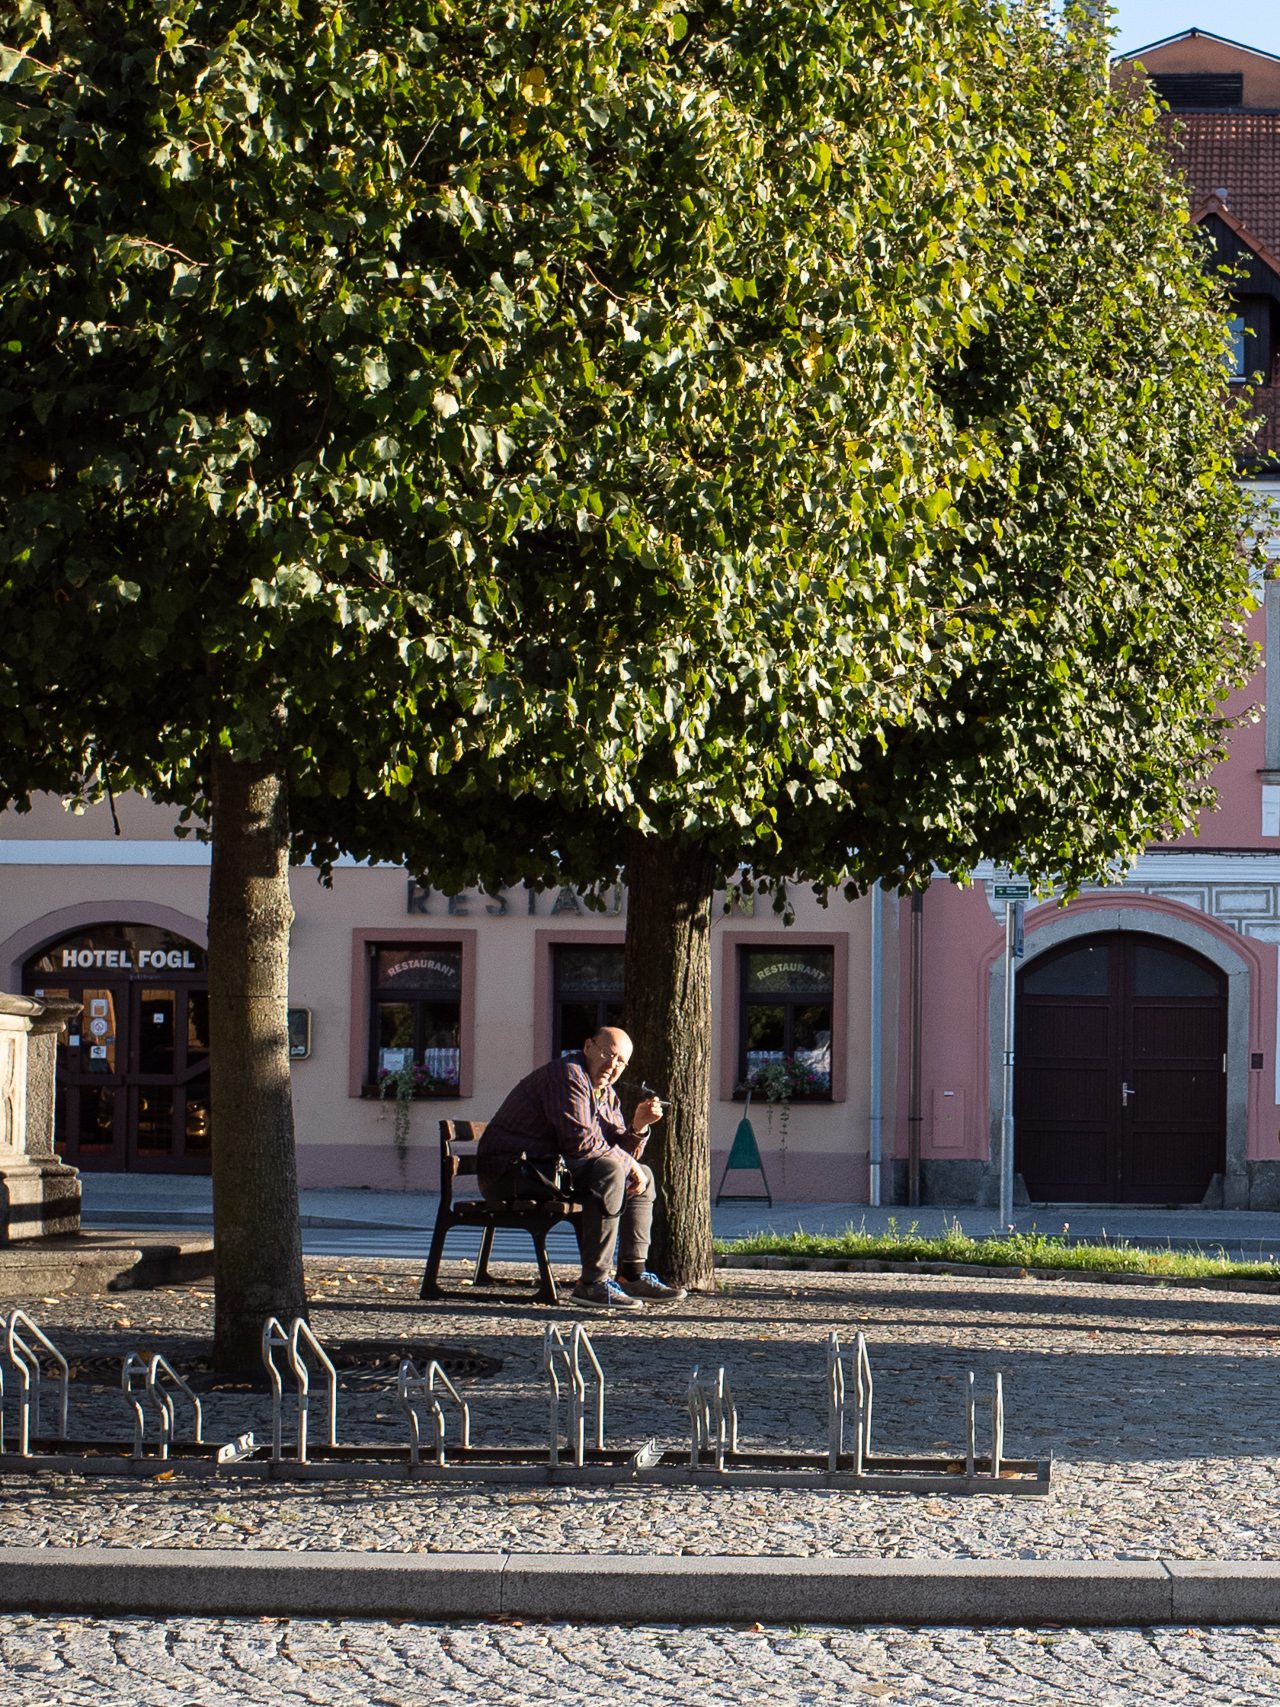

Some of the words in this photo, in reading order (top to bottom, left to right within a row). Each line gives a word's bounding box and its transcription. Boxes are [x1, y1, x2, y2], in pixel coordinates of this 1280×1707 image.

[62, 949, 132, 968] HOTEL
[138, 950, 196, 969] FOGL
[387, 959, 455, 977] RESTAURANT
[756, 963, 826, 981] RESTAURANT
